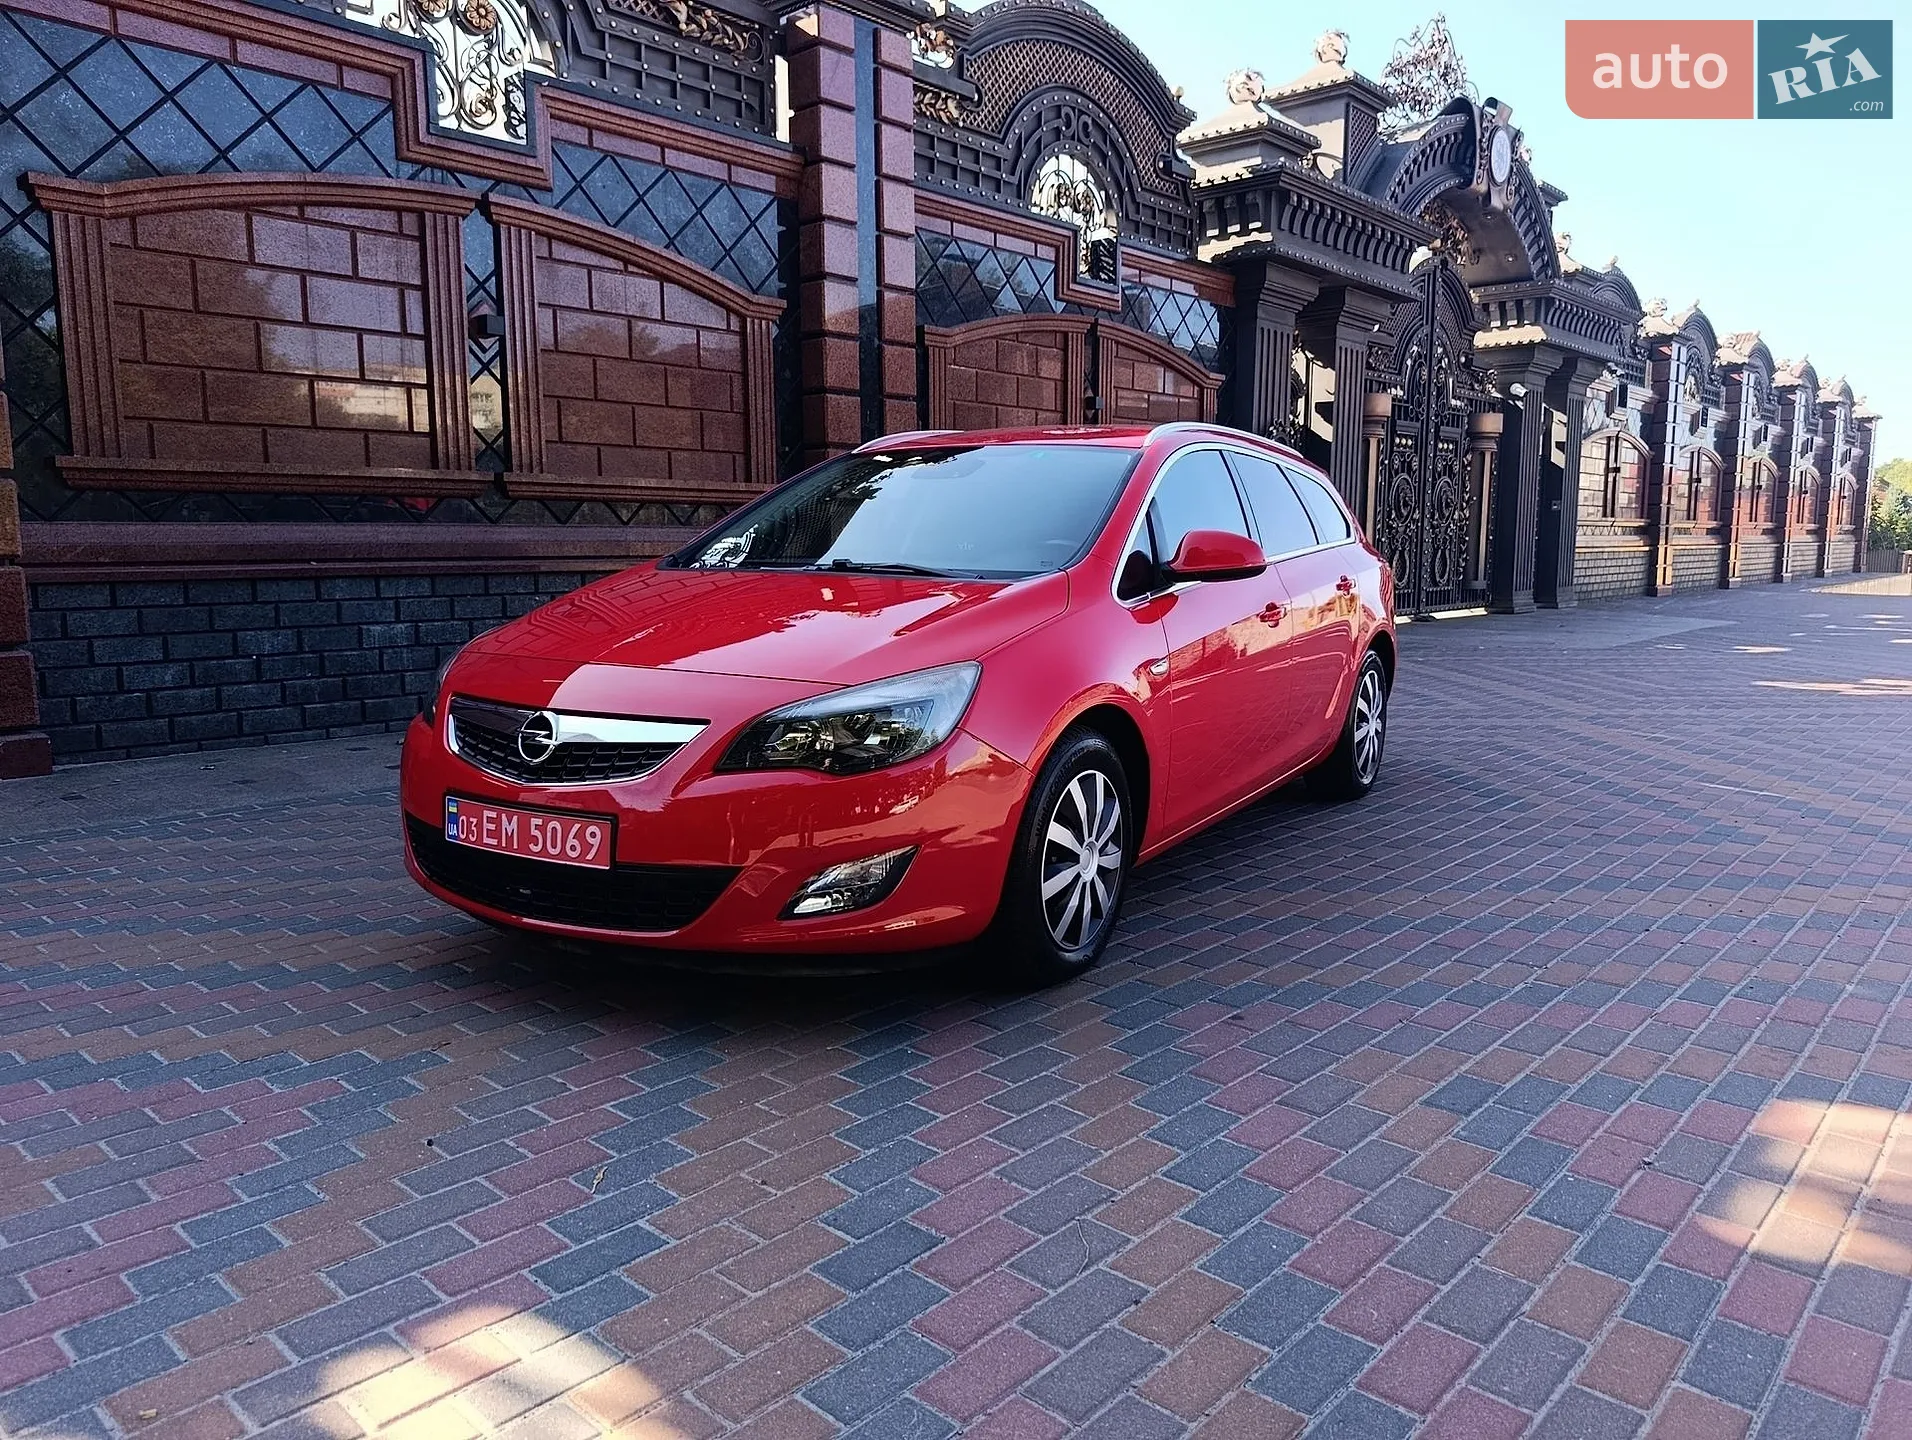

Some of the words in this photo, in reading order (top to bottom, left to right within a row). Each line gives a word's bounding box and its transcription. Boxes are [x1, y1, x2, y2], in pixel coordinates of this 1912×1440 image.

[448, 822, 458, 837] UA
[458, 815, 477, 842] 03
[482, 809, 519, 849] EM
[529, 817, 602, 860] 5069
